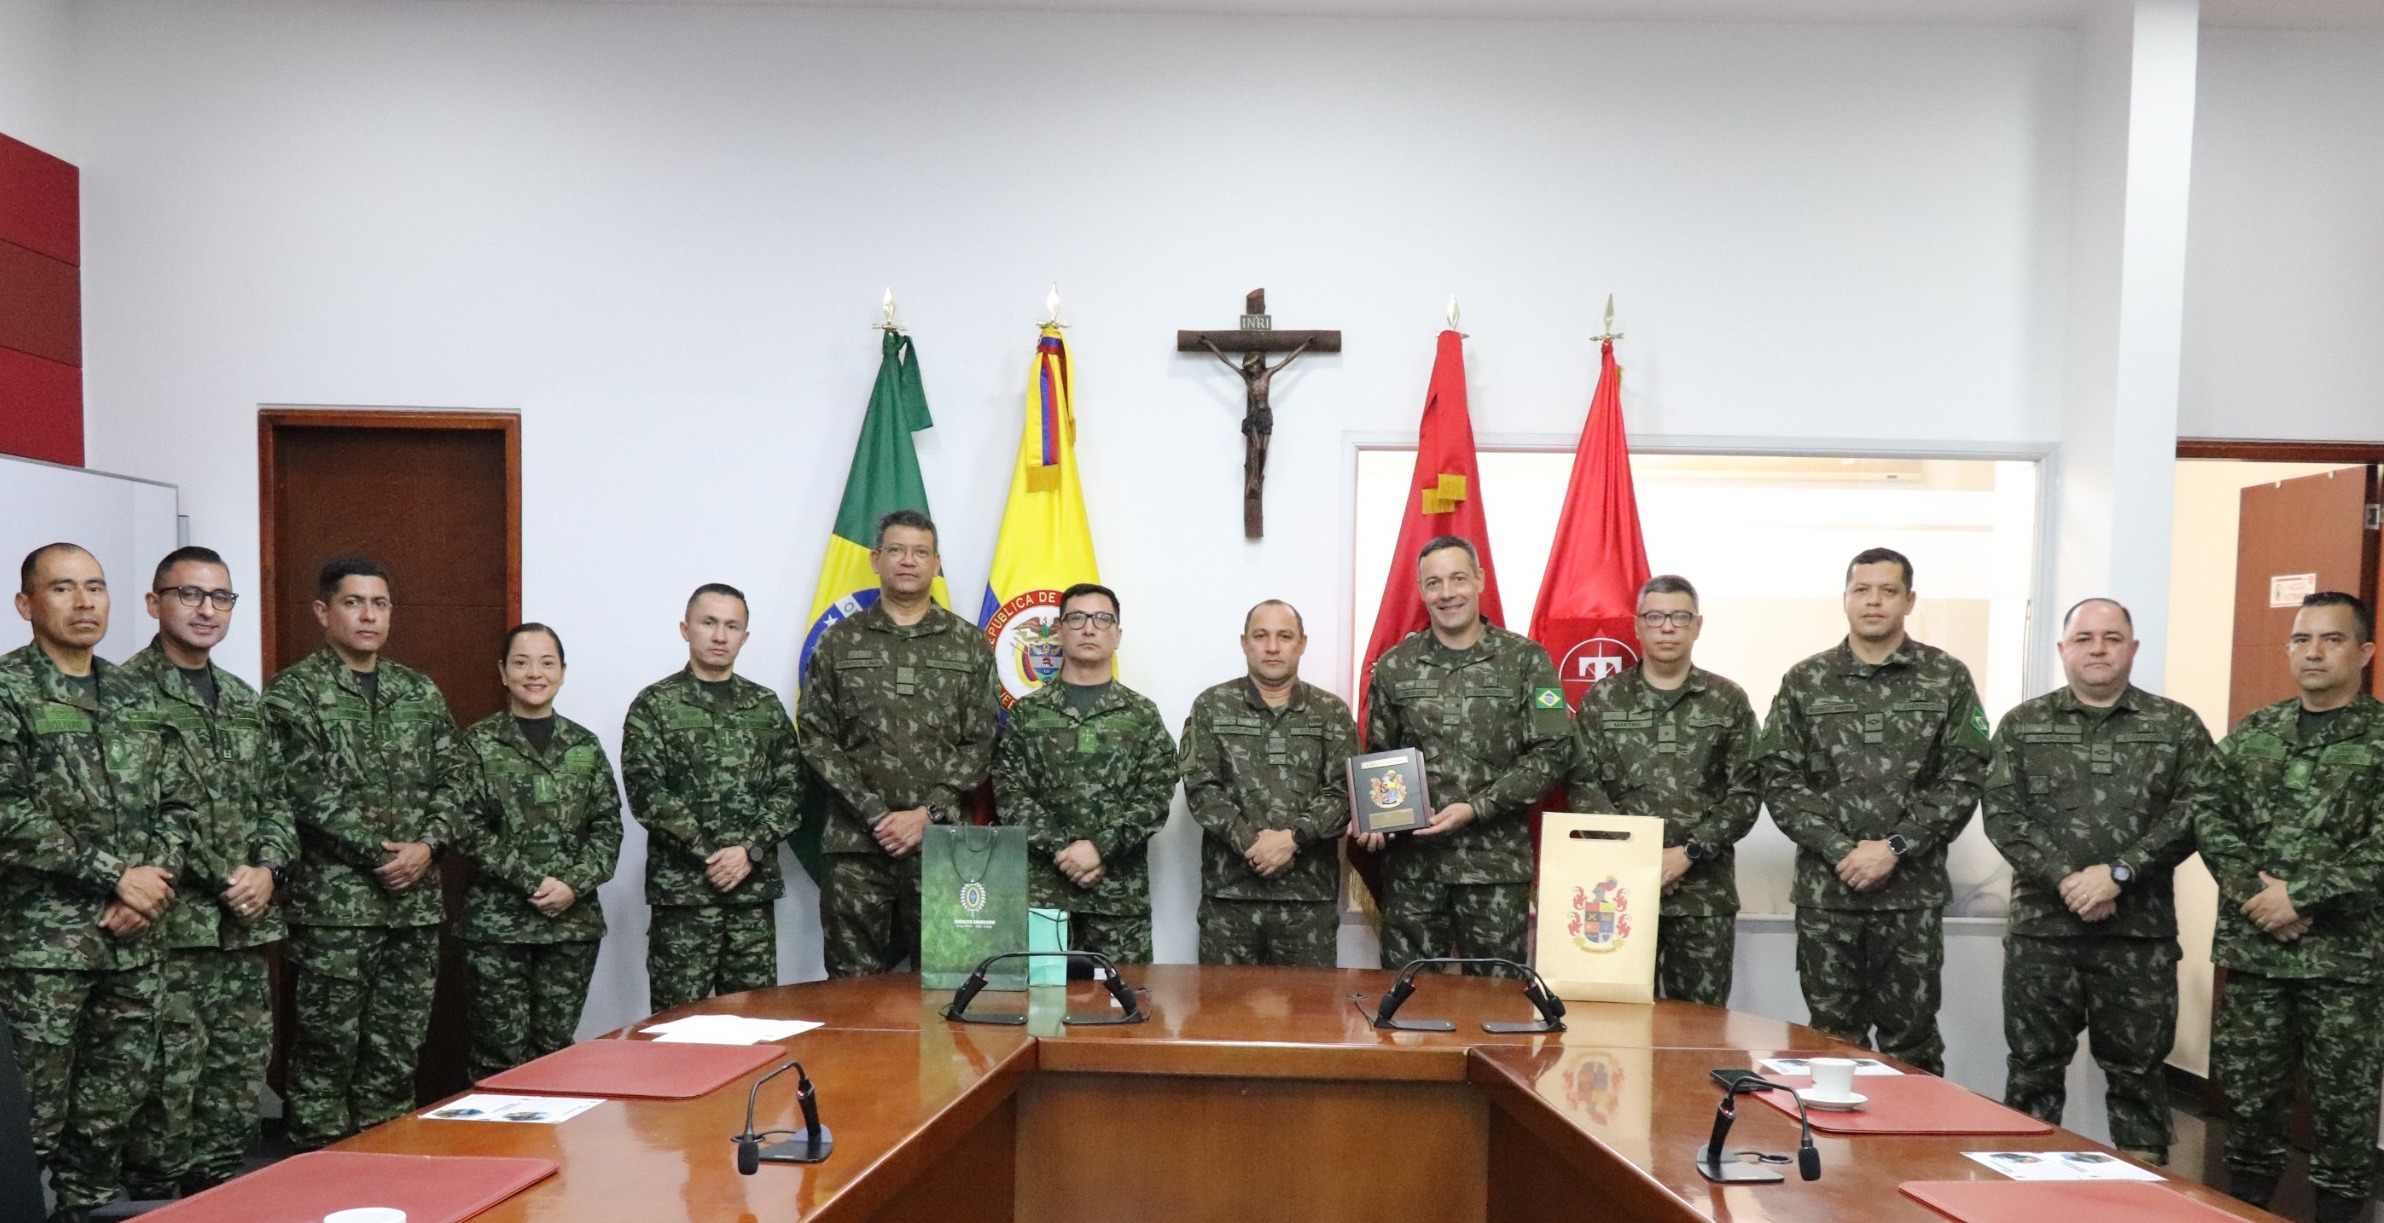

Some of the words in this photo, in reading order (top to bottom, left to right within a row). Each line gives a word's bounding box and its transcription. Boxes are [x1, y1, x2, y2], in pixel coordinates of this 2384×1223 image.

[1242, 317, 1269, 329] INRI
[988, 594, 1034, 646] PUBLICA
[1039, 592, 1057, 603] DE
